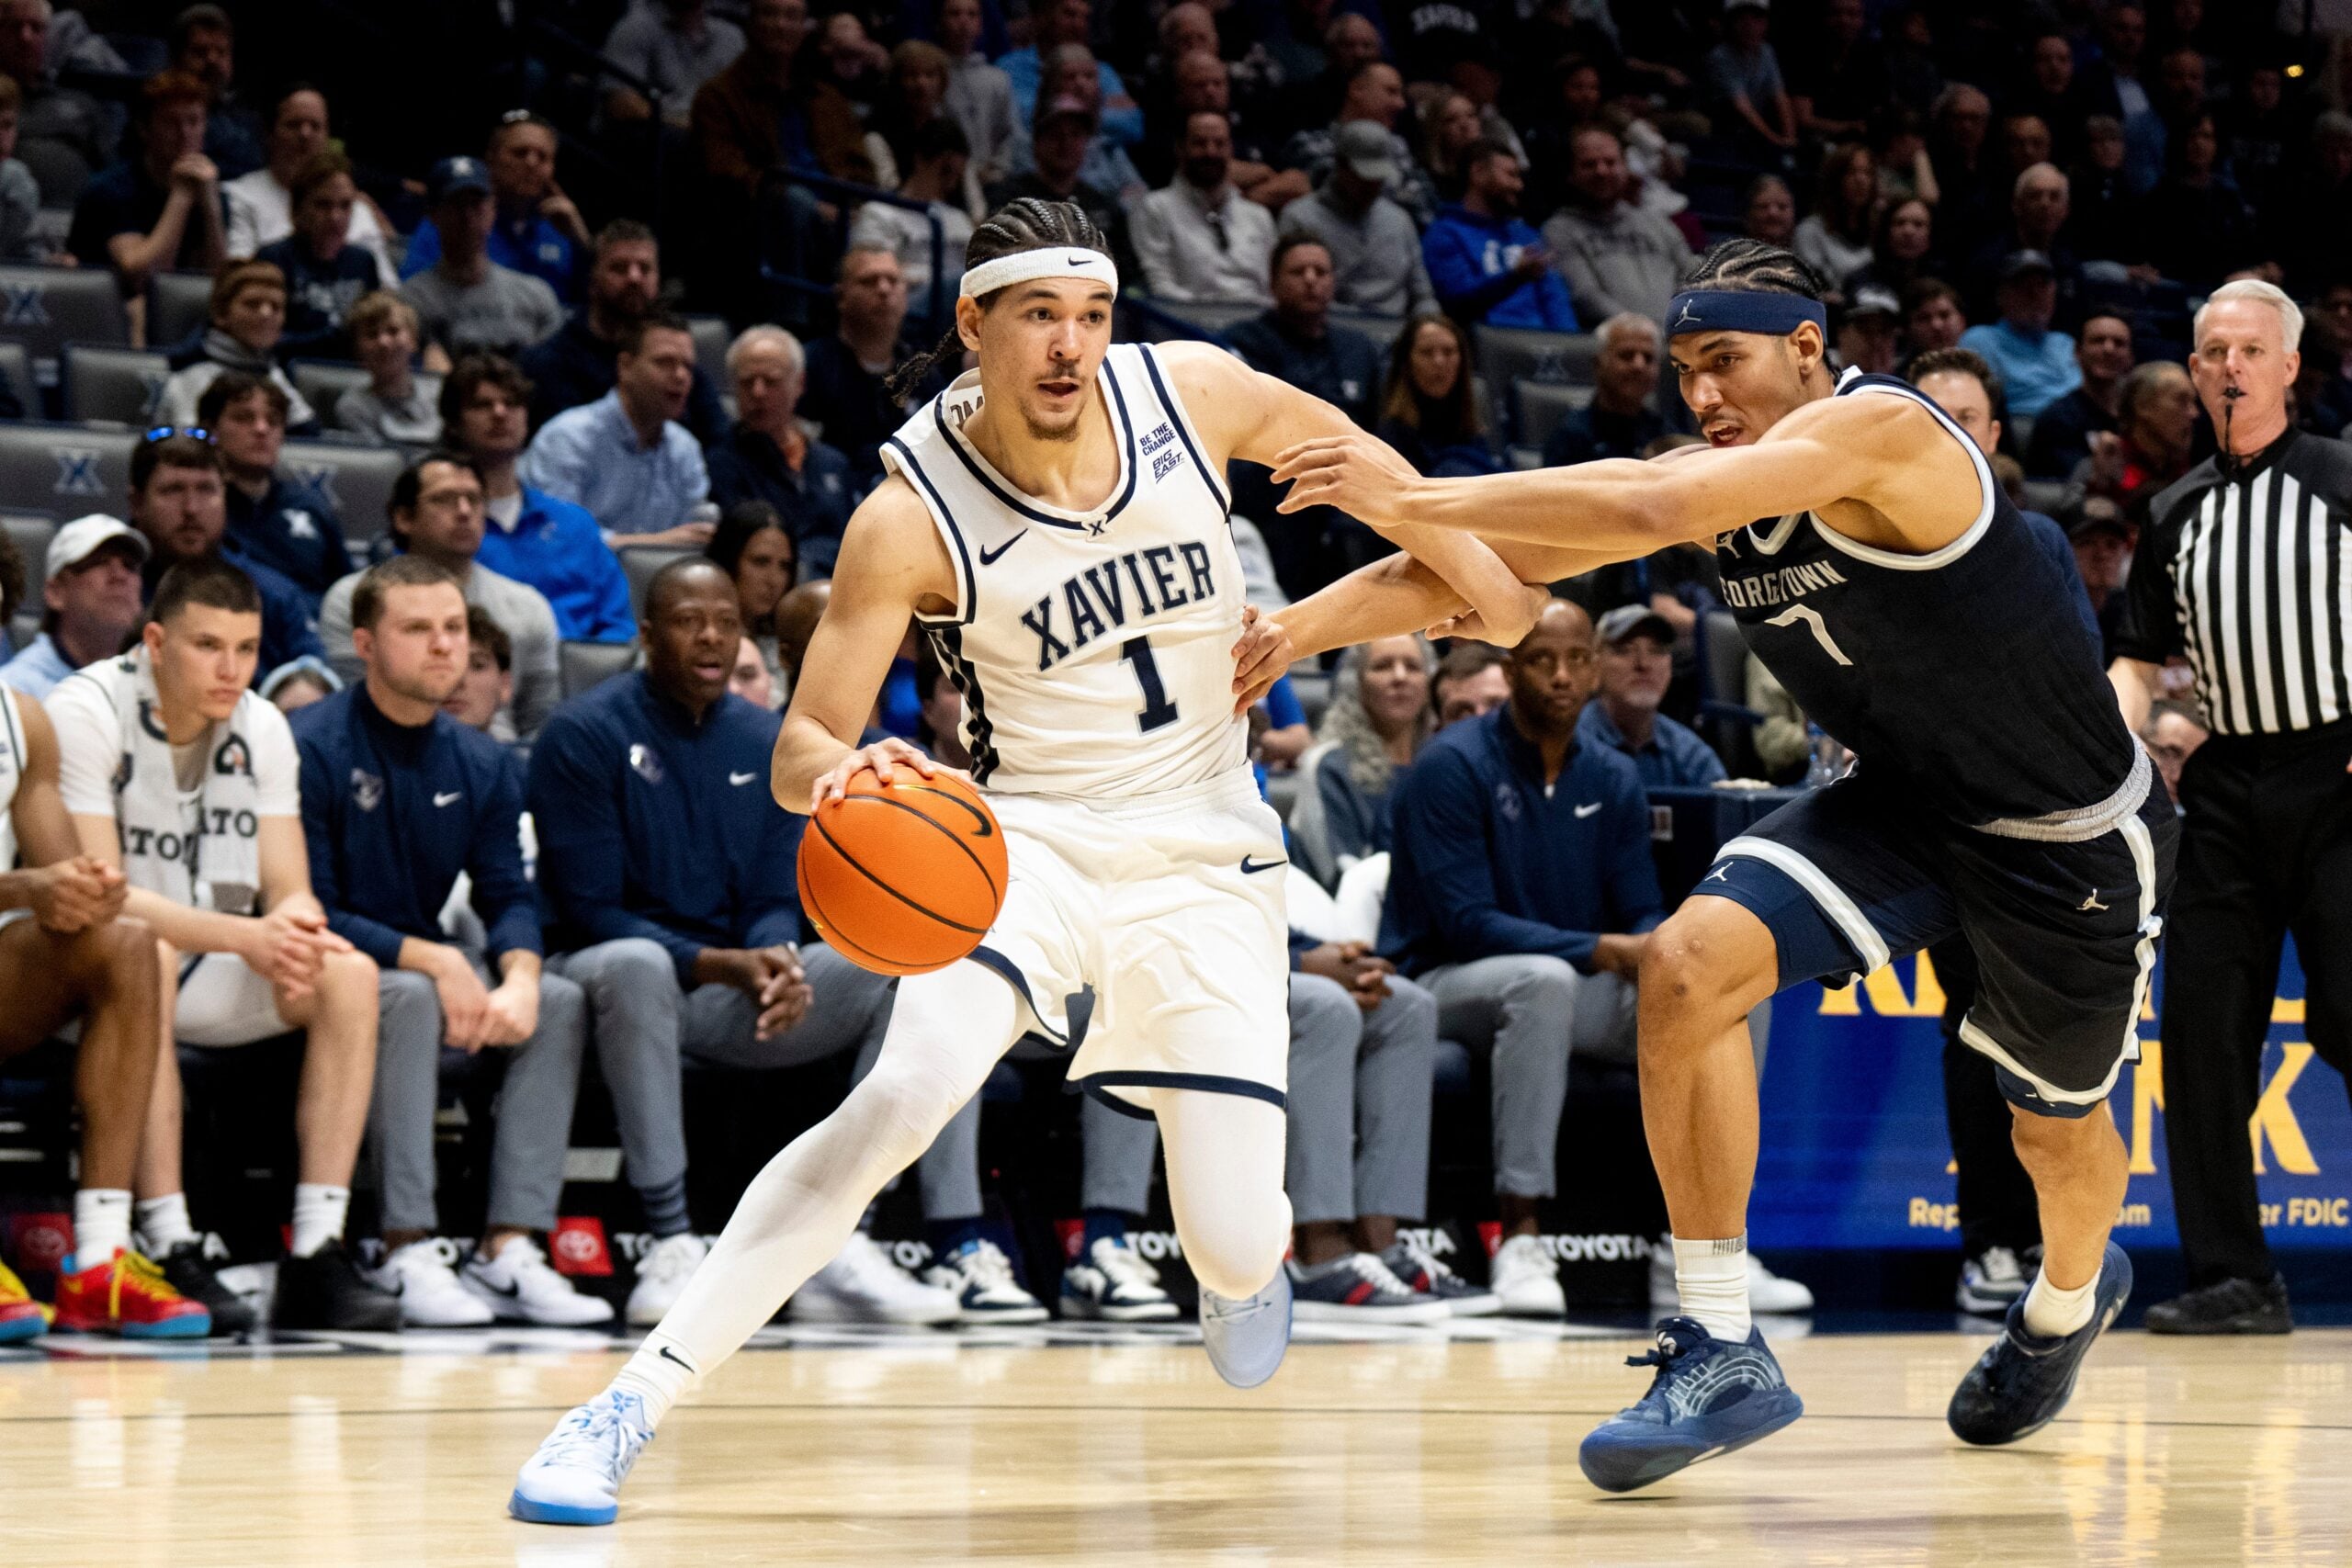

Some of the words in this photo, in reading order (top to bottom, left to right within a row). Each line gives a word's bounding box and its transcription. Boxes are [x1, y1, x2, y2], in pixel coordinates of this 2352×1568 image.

[1139, 434, 1152, 446] BE
[1151, 422, 1170, 439] THE
[1142, 429, 1176, 456] CHANGE
[1152, 449, 1172, 470] BIG
[1154, 451, 1182, 479] EAST
[1018, 539, 1216, 672] XAVIER
[1764, 604, 1854, 666] 7
[1119, 634, 1181, 736] 1
[2289, 1198, 2349, 1226] FDIC
